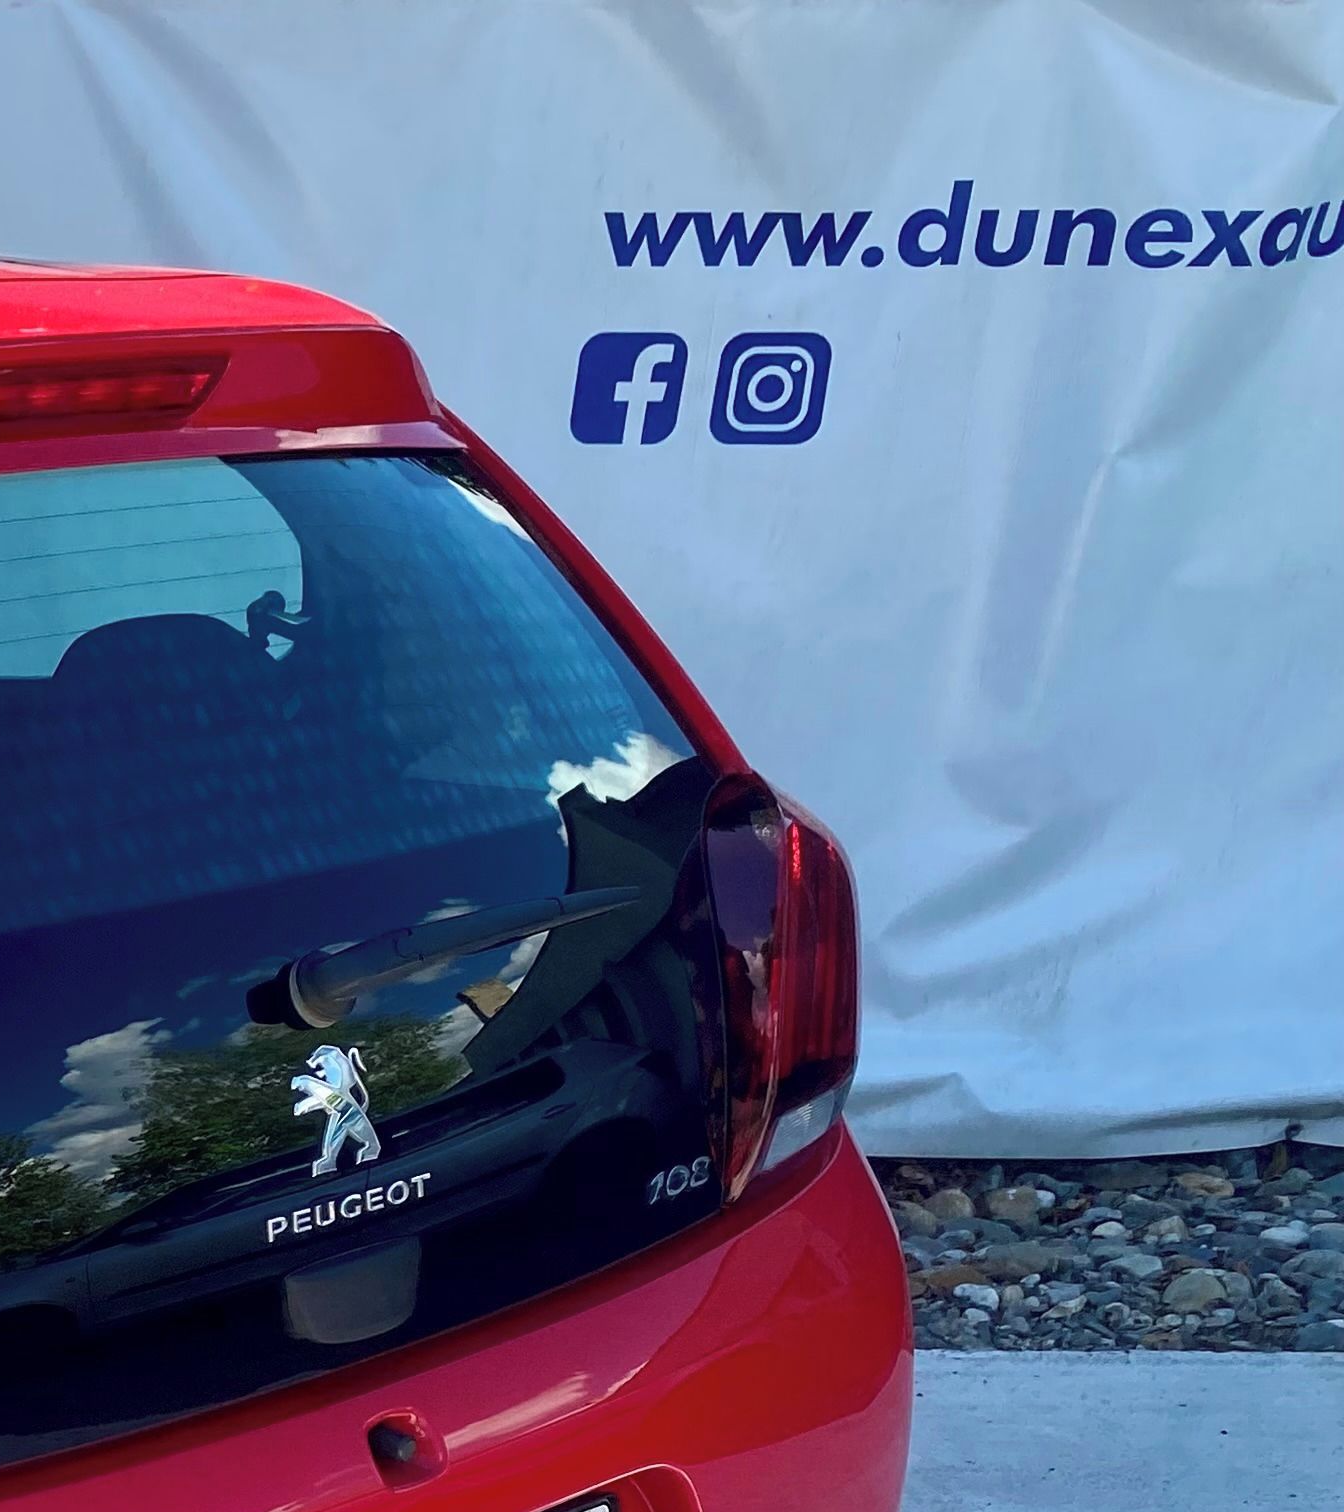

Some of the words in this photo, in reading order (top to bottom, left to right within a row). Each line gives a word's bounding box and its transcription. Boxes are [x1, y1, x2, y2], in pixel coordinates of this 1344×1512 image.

[604, 179, 1344, 269] www.dunexau
[265, 1172, 432, 1243] PEUGEOT
[647, 1156, 711, 1206] 108
